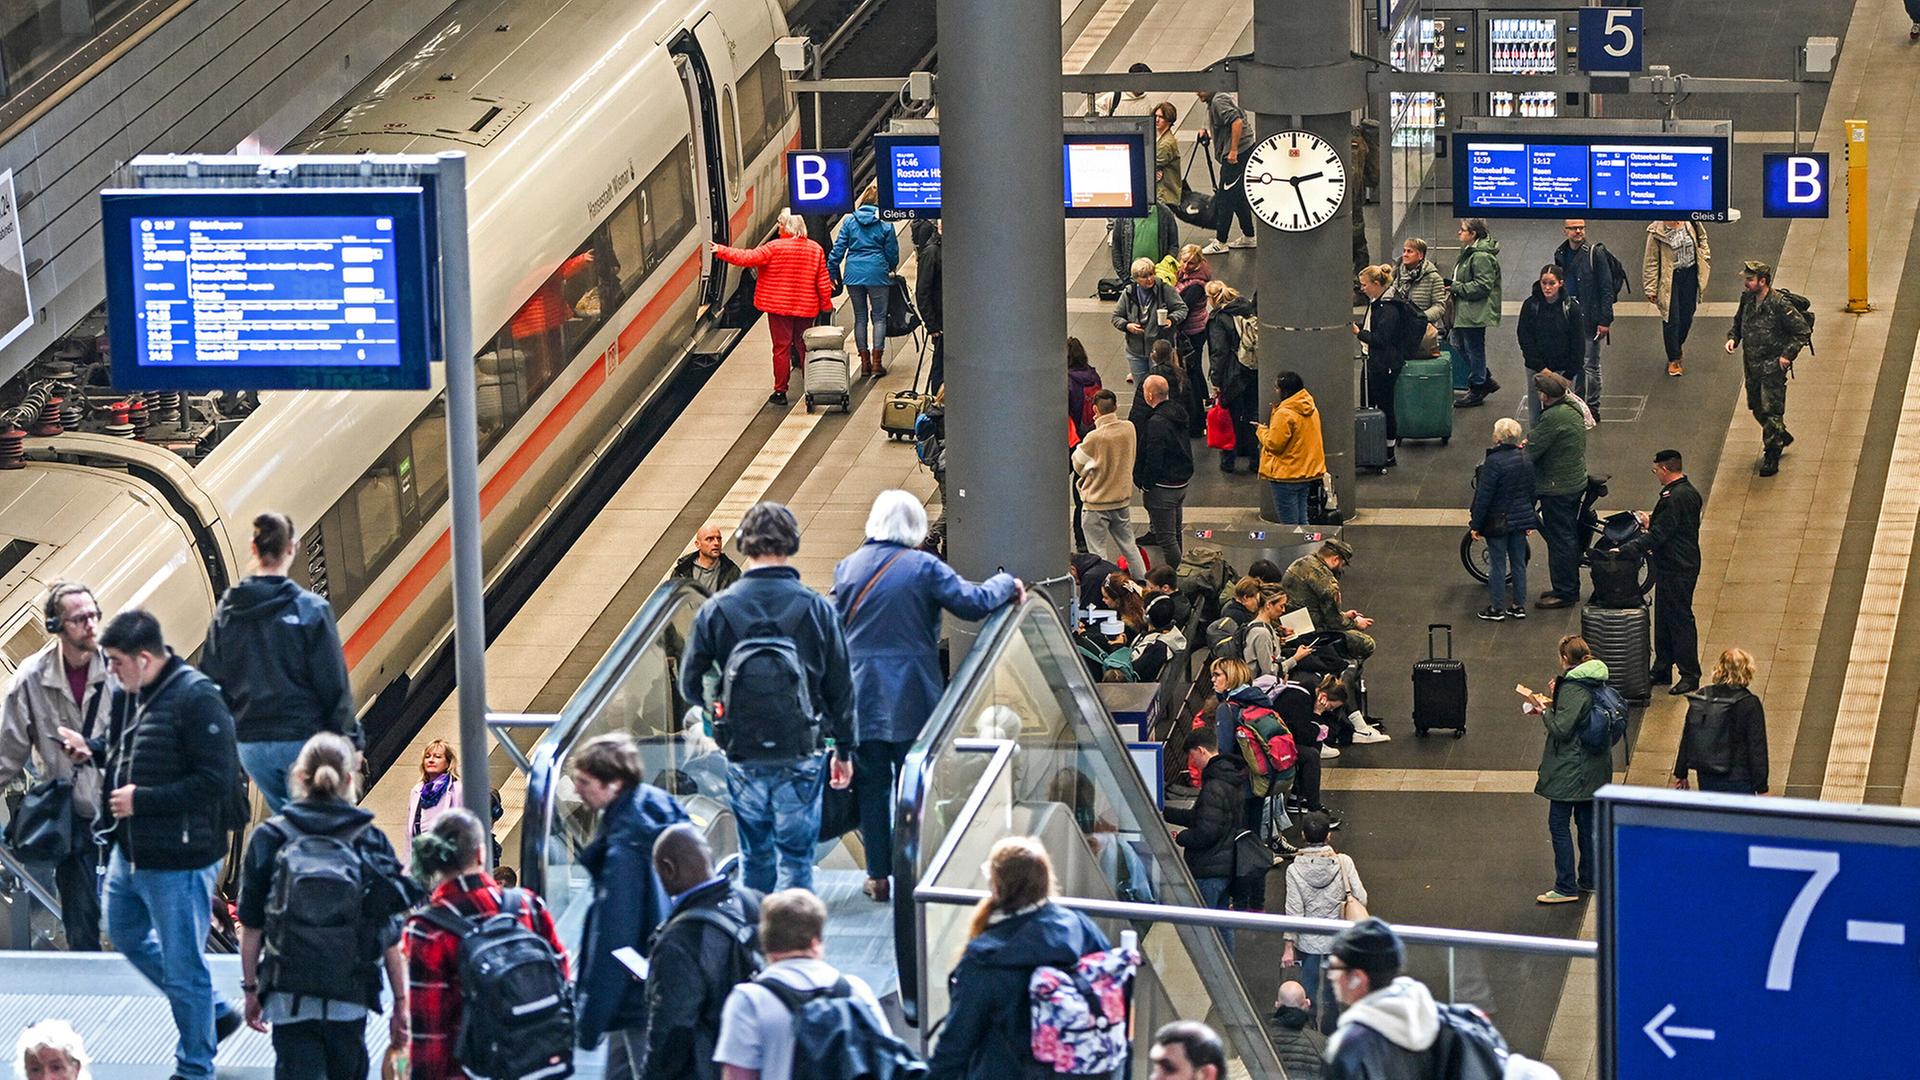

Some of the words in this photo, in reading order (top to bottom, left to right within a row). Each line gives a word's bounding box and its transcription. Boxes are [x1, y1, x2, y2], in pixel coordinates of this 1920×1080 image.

[1602, 10, 1634, 57] 5
[896, 158, 919, 168] 14:46
[1473, 156, 1491, 165] 15:39
[1533, 157, 1551, 166] 15:12
[796, 155, 830, 201] B
[897, 168, 930, 179] Rostock
[1787, 157, 1822, 203] B
[641, 190, 649, 224] 2
[883, 209, 907, 219] Gleis
[908, 209, 916, 219] 6
[1691, 211, 1716, 221] Gleis
[1717, 212, 1724, 221] 5
